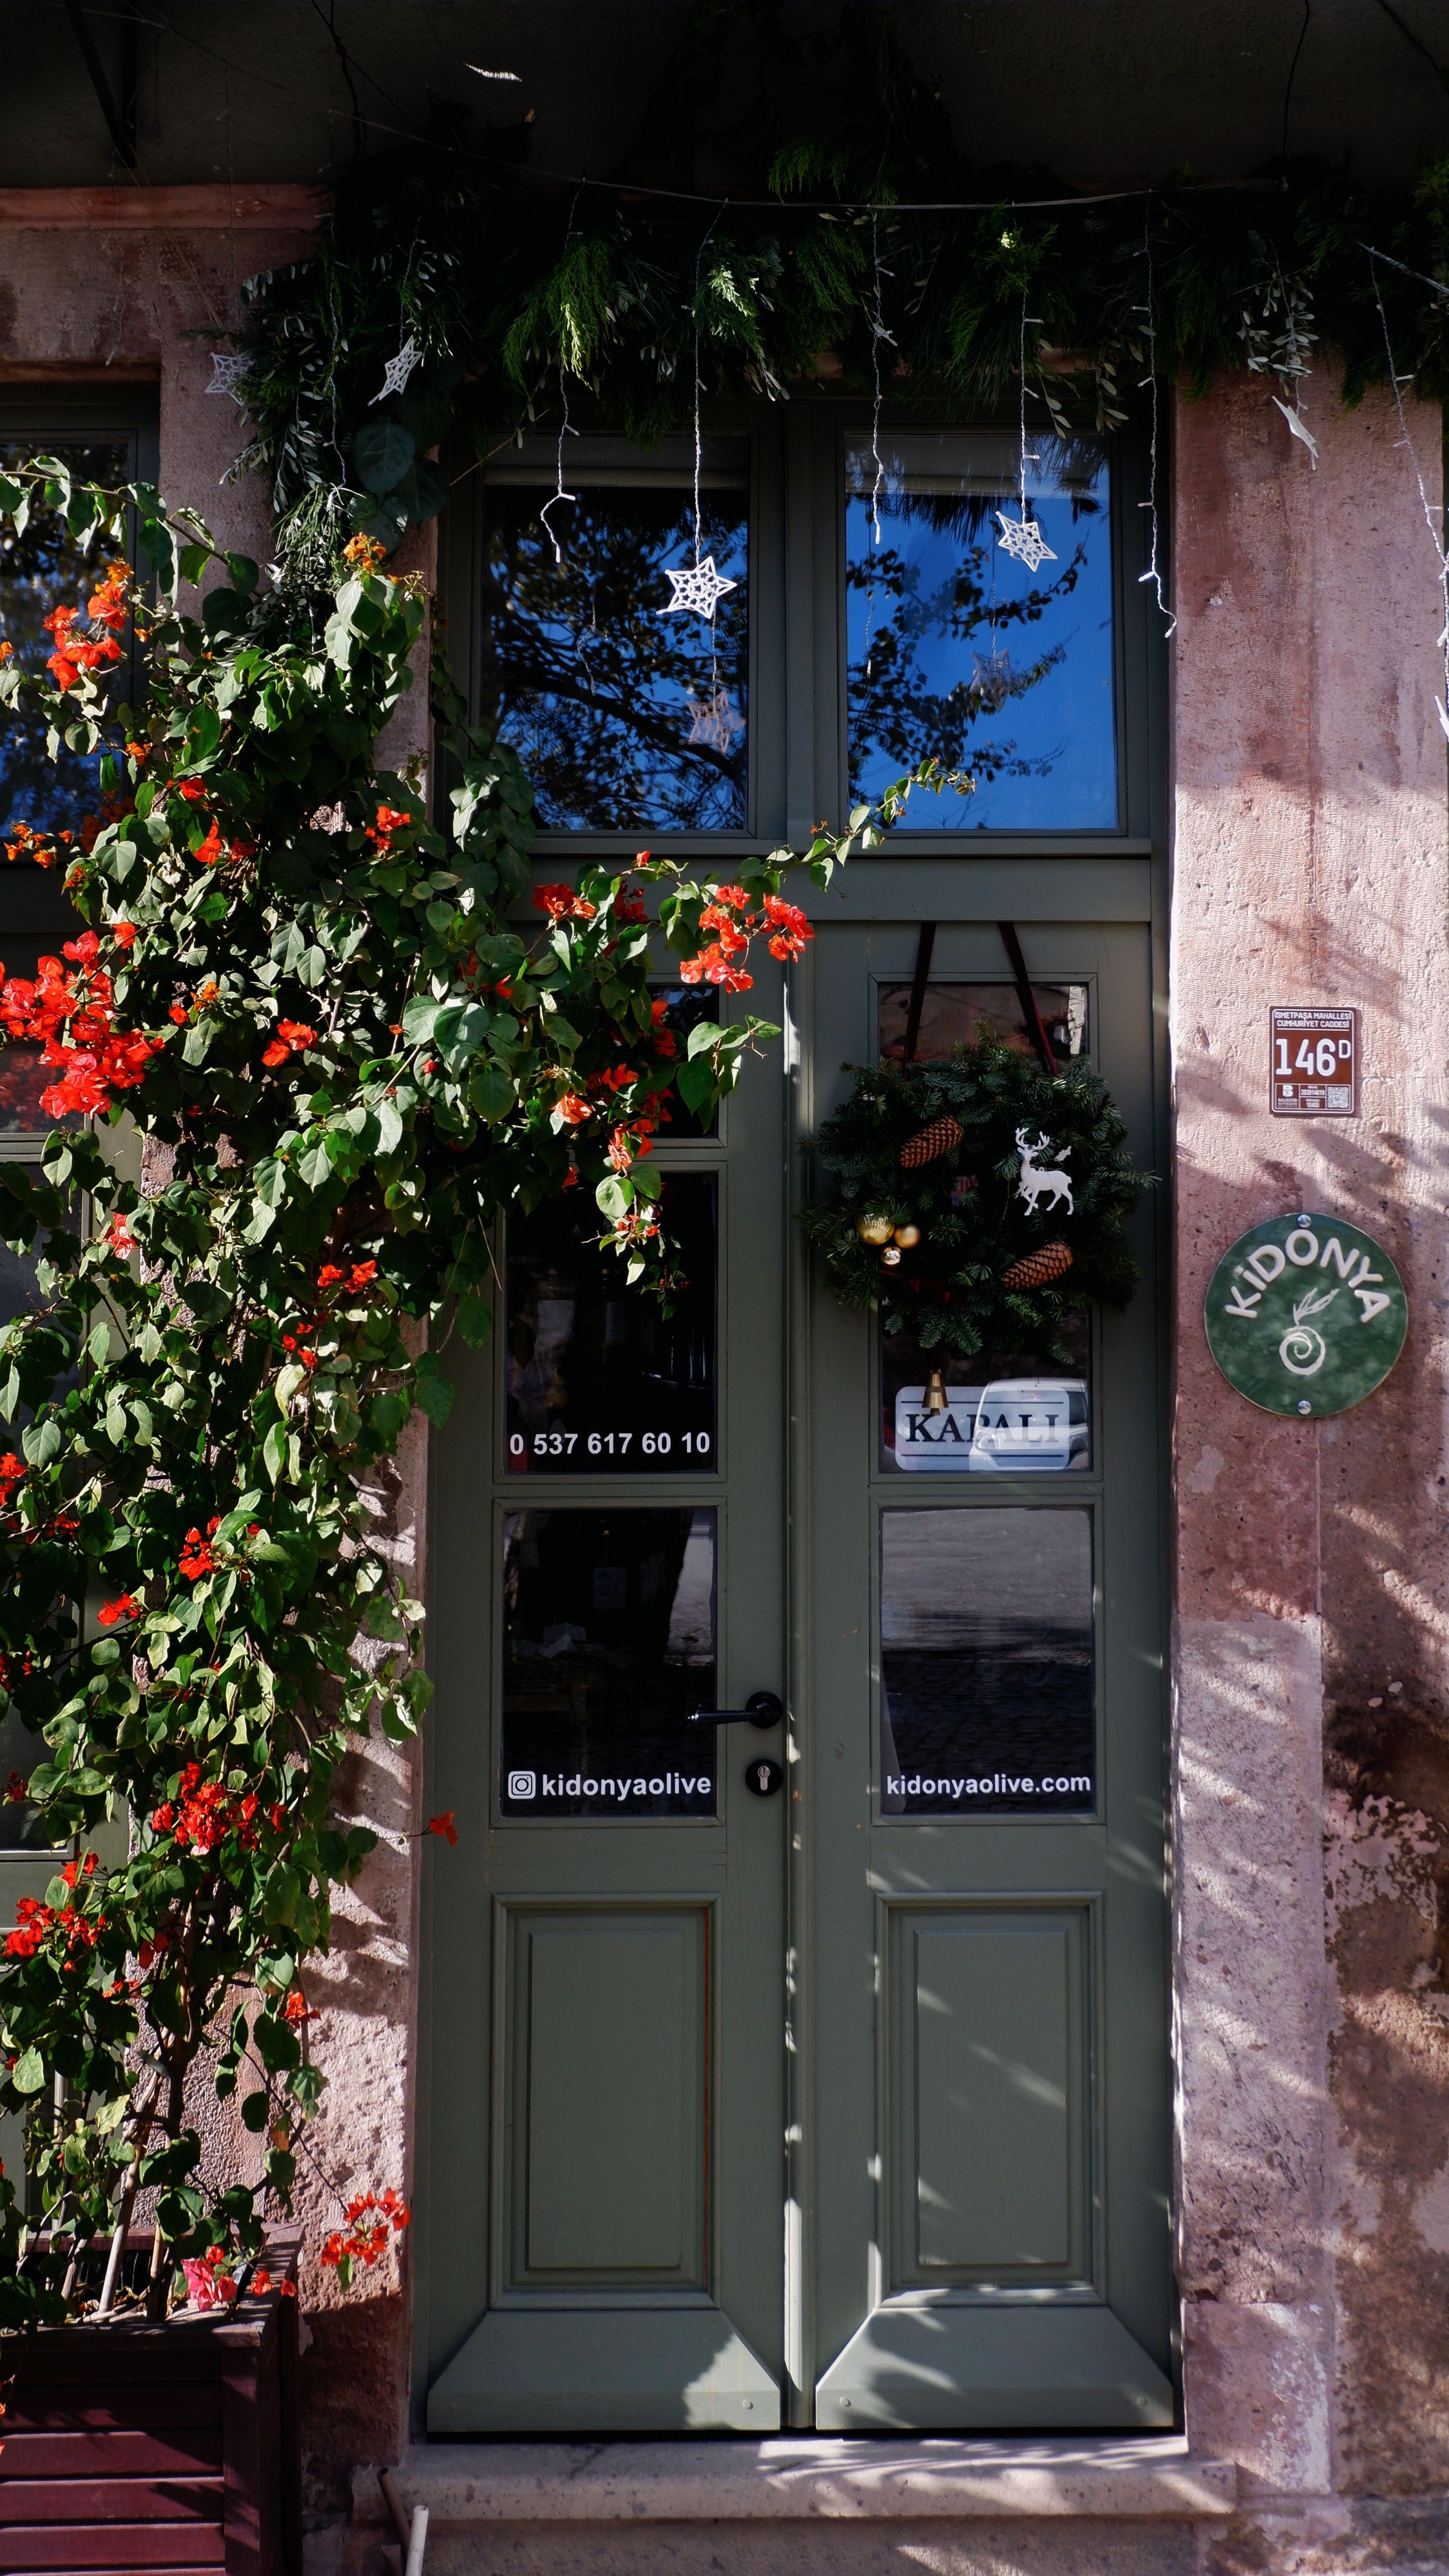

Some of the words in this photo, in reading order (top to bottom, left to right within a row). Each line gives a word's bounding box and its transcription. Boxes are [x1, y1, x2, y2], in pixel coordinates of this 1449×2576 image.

[1274, 1011, 1313, 1020] İSMETPAŞA
[1313, 1012, 1352, 1020] MAHALLESİ
[905, 1413, 1059, 1443] KAPALI
[510, 1433, 524, 1454] 0
[533, 1433, 578, 1455] 537
[587, 1432, 632, 1454] 617
[642, 1432, 671, 1453] 60
[681, 1432, 710, 1453] 10
[542, 1772, 711, 1801] kidonyaolive
[887, 1773, 1091, 1799] kidonyaolive.com
